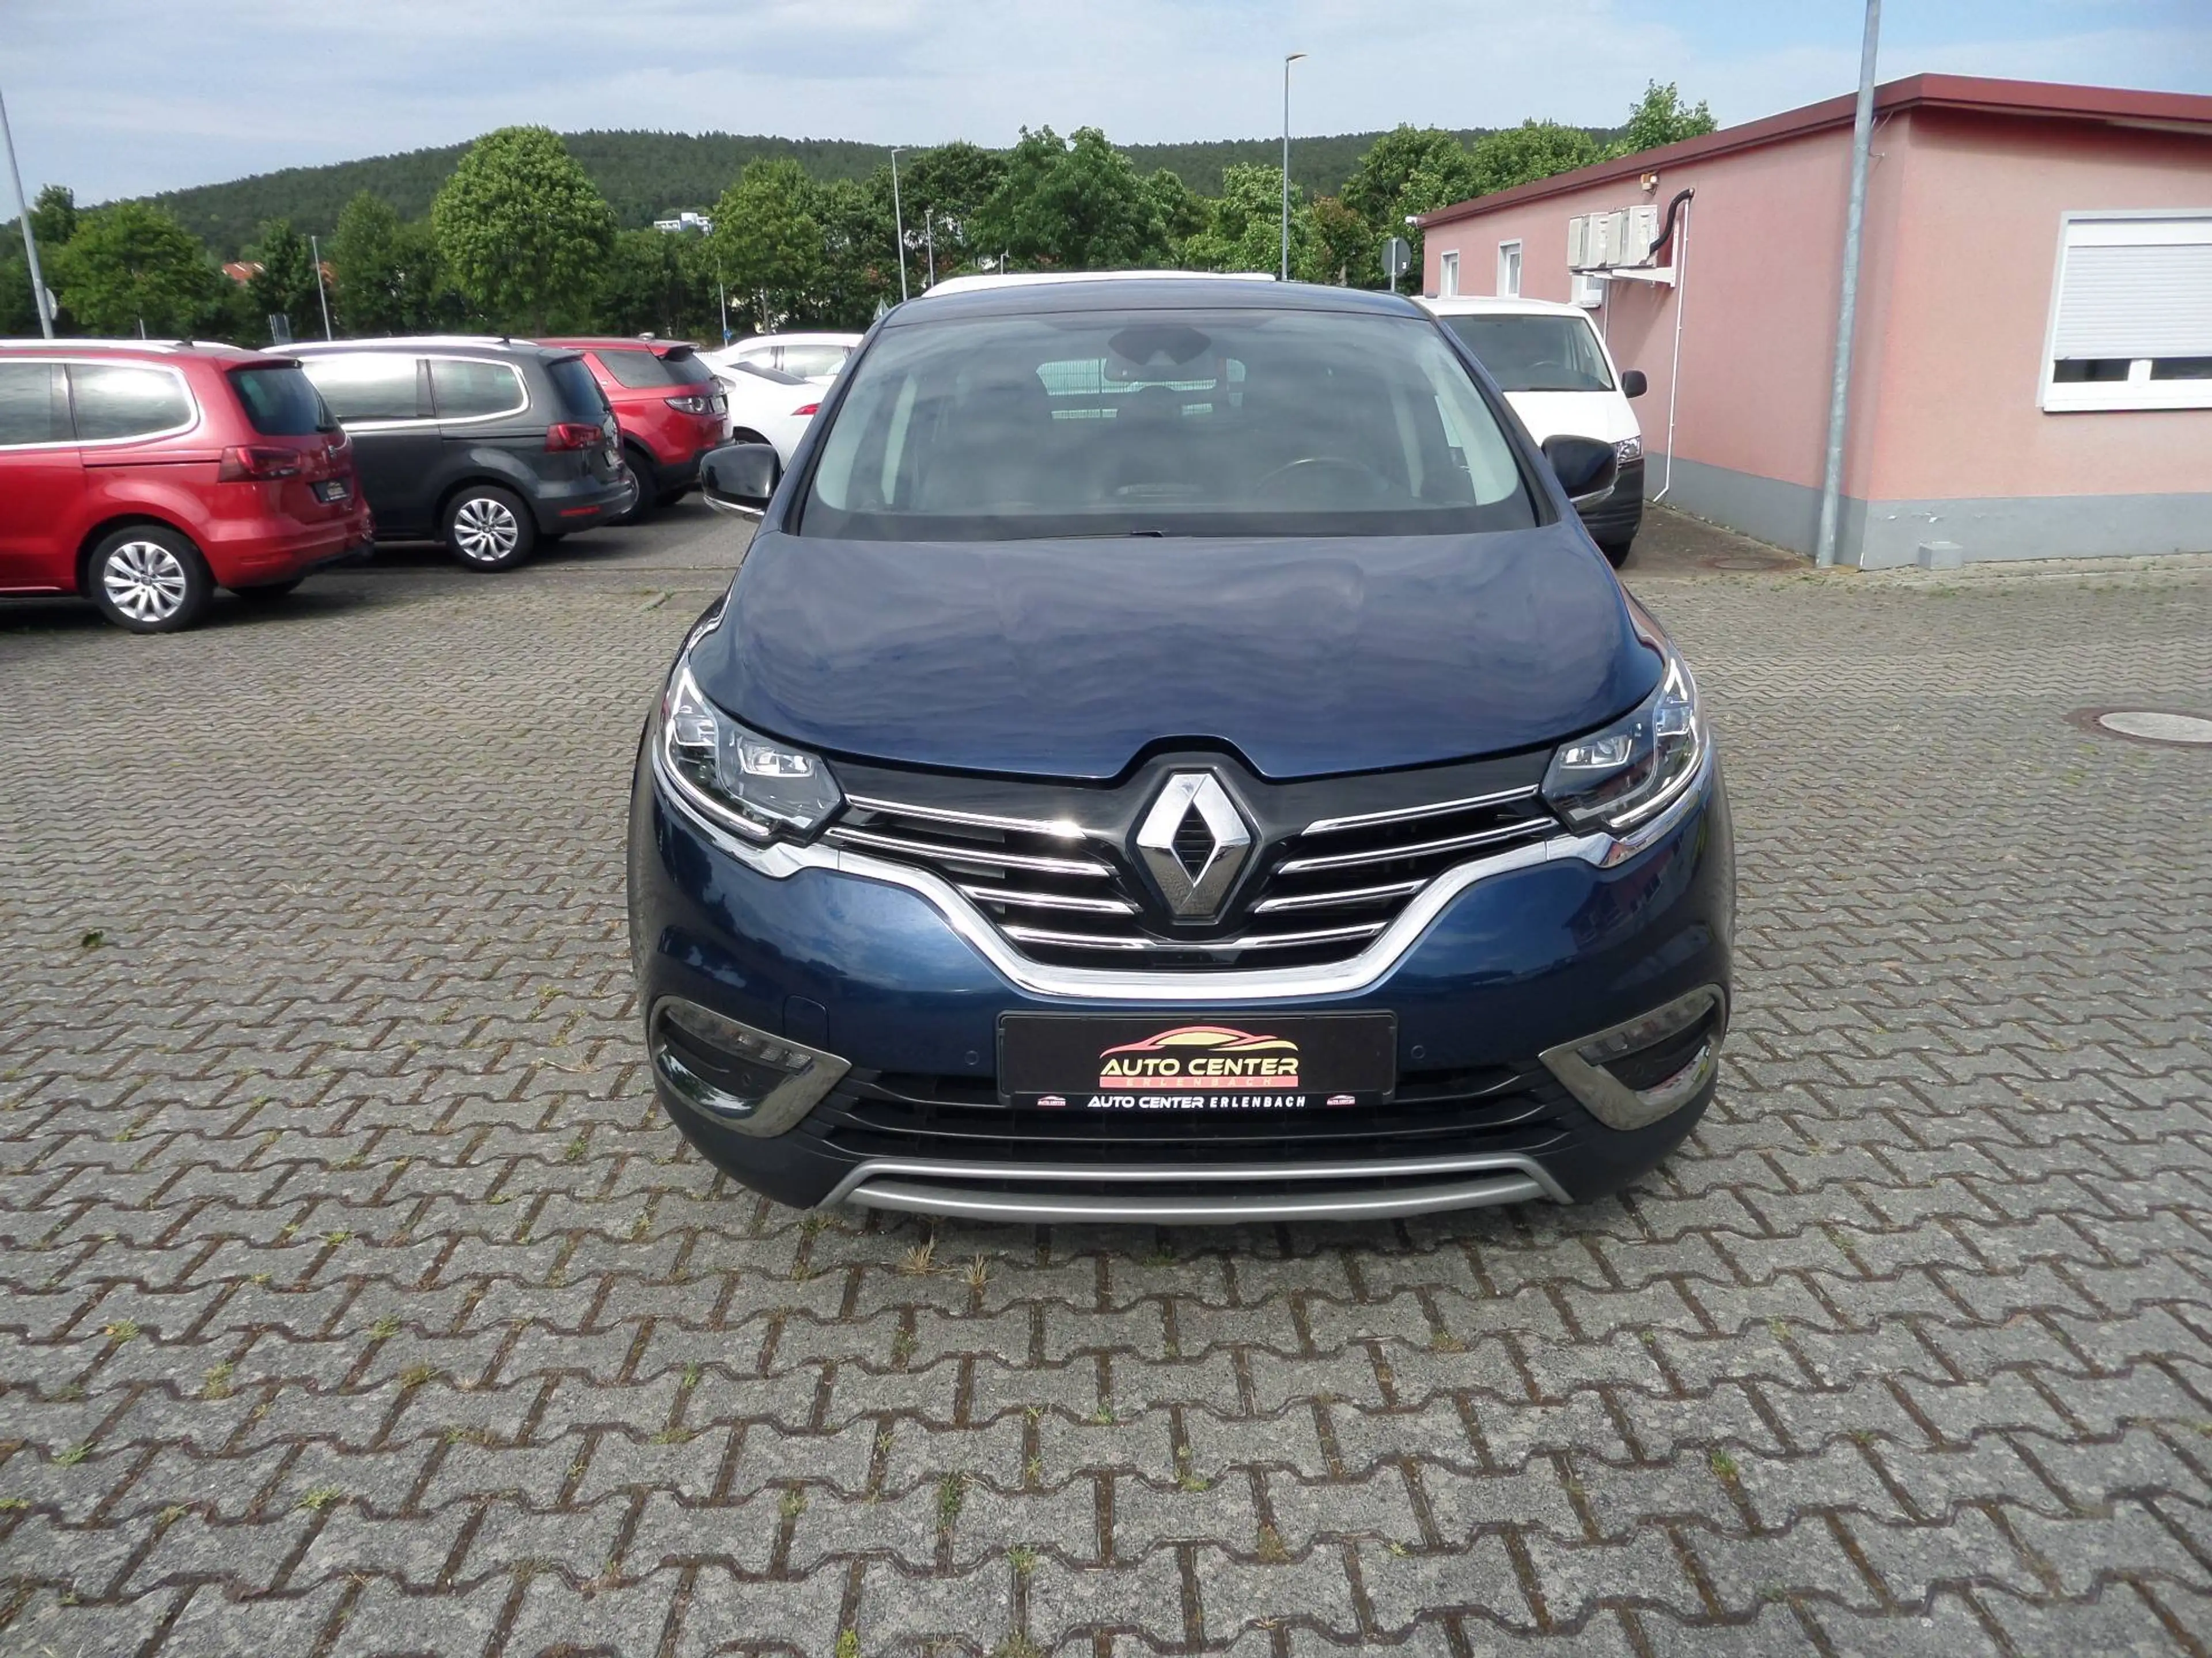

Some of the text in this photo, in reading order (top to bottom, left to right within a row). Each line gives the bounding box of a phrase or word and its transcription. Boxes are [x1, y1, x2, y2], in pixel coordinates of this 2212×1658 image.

[1100, 1058, 1298, 1076] AUTO CENTER
[1126, 1077, 1272, 1087] ERLENBACH
[1088, 1095, 1305, 1109] AUTO CENTER ERLENBACH
